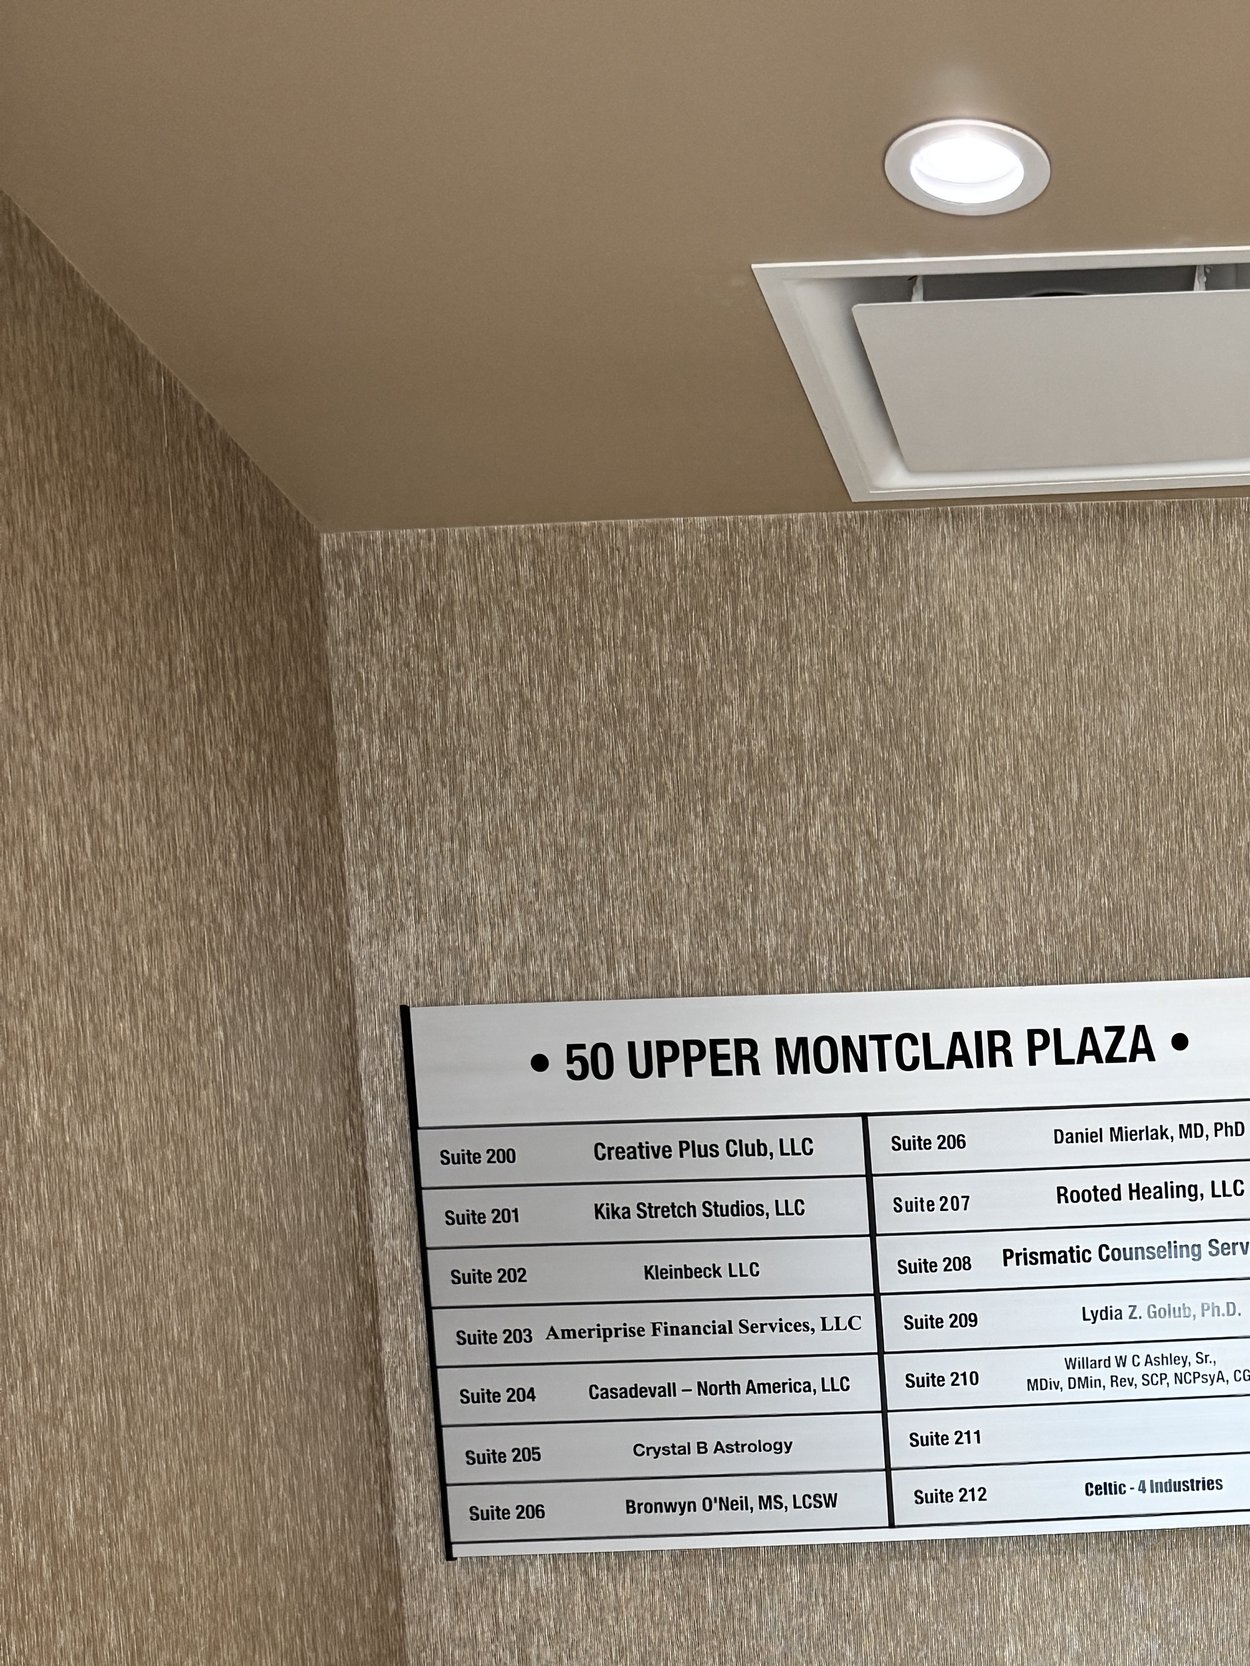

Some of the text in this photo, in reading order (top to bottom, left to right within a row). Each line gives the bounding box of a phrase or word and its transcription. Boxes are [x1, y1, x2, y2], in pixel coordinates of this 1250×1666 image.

[566, 1025, 1156, 1081] 50 UPPER MONTCLAIR PLAZA
[1054, 1121, 1245, 1144] Daniel Mierlak, MD, PhD
[594, 1137, 813, 1161] Creative Plus Club, LLC
[891, 1134, 966, 1151] Suite 206
[440, 1148, 516, 1165] Suite 200
[1057, 1179, 1244, 1204] Rooted Healing, LLC
[594, 1199, 805, 1220] Kika Stretch Studios, LLC
[893, 1195, 970, 1213] Suite 207
[445, 1208, 519, 1225] Suite 201
[1003, 1245, 1092, 1267] Prismatic
[1098, 1240, 1201, 1262] Counseling
[644, 1262, 759, 1280] Kleinbeck LLC
[897, 1256, 972, 1274] Suite 208
[451, 1267, 527, 1285] Suite 202
[904, 1313, 978, 1330] Suite 209
[1082, 1302, 1241, 1324] Lydia Z. Golub, Ph.D.
[456, 1328, 533, 1345] Suite 203
[545, 1316, 861, 1342] Ameriprise Financial Services, LLC
[1064, 1352, 1216, 1370] Willard W C Ashley, Sr.,
[589, 1382, 676, 1399] Casadevall
[697, 1380, 741, 1396] North
[746, 1378, 816, 1395] America,
[821, 1376, 850, 1392] LLC
[905, 1371, 979, 1388] Suite 210
[1027, 1378, 1063, 1392] MDiv,
[1068, 1376, 1105, 1391] DMin,
[1110, 1375, 1137, 1389] Rev,
[1142, 1373, 1169, 1388] SCP,
[1174, 1370, 1229, 1386] NCPsyA,
[460, 1387, 536, 1404] Suite 204
[909, 1430, 980, 1447] Suite 211
[465, 1447, 541, 1465] Suite 205
[633, 1439, 793, 1459] Crystal B Astrology
[914, 1487, 987, 1504] Suite 212
[1085, 1481, 1126, 1496] Celtic
[1138, 1480, 1146, 1494] 4
[1150, 1477, 1223, 1493] Industries
[469, 1504, 545, 1521] Suite 206
[626, 1493, 837, 1516] Bronwyn O'Neil, MS, LCSW
